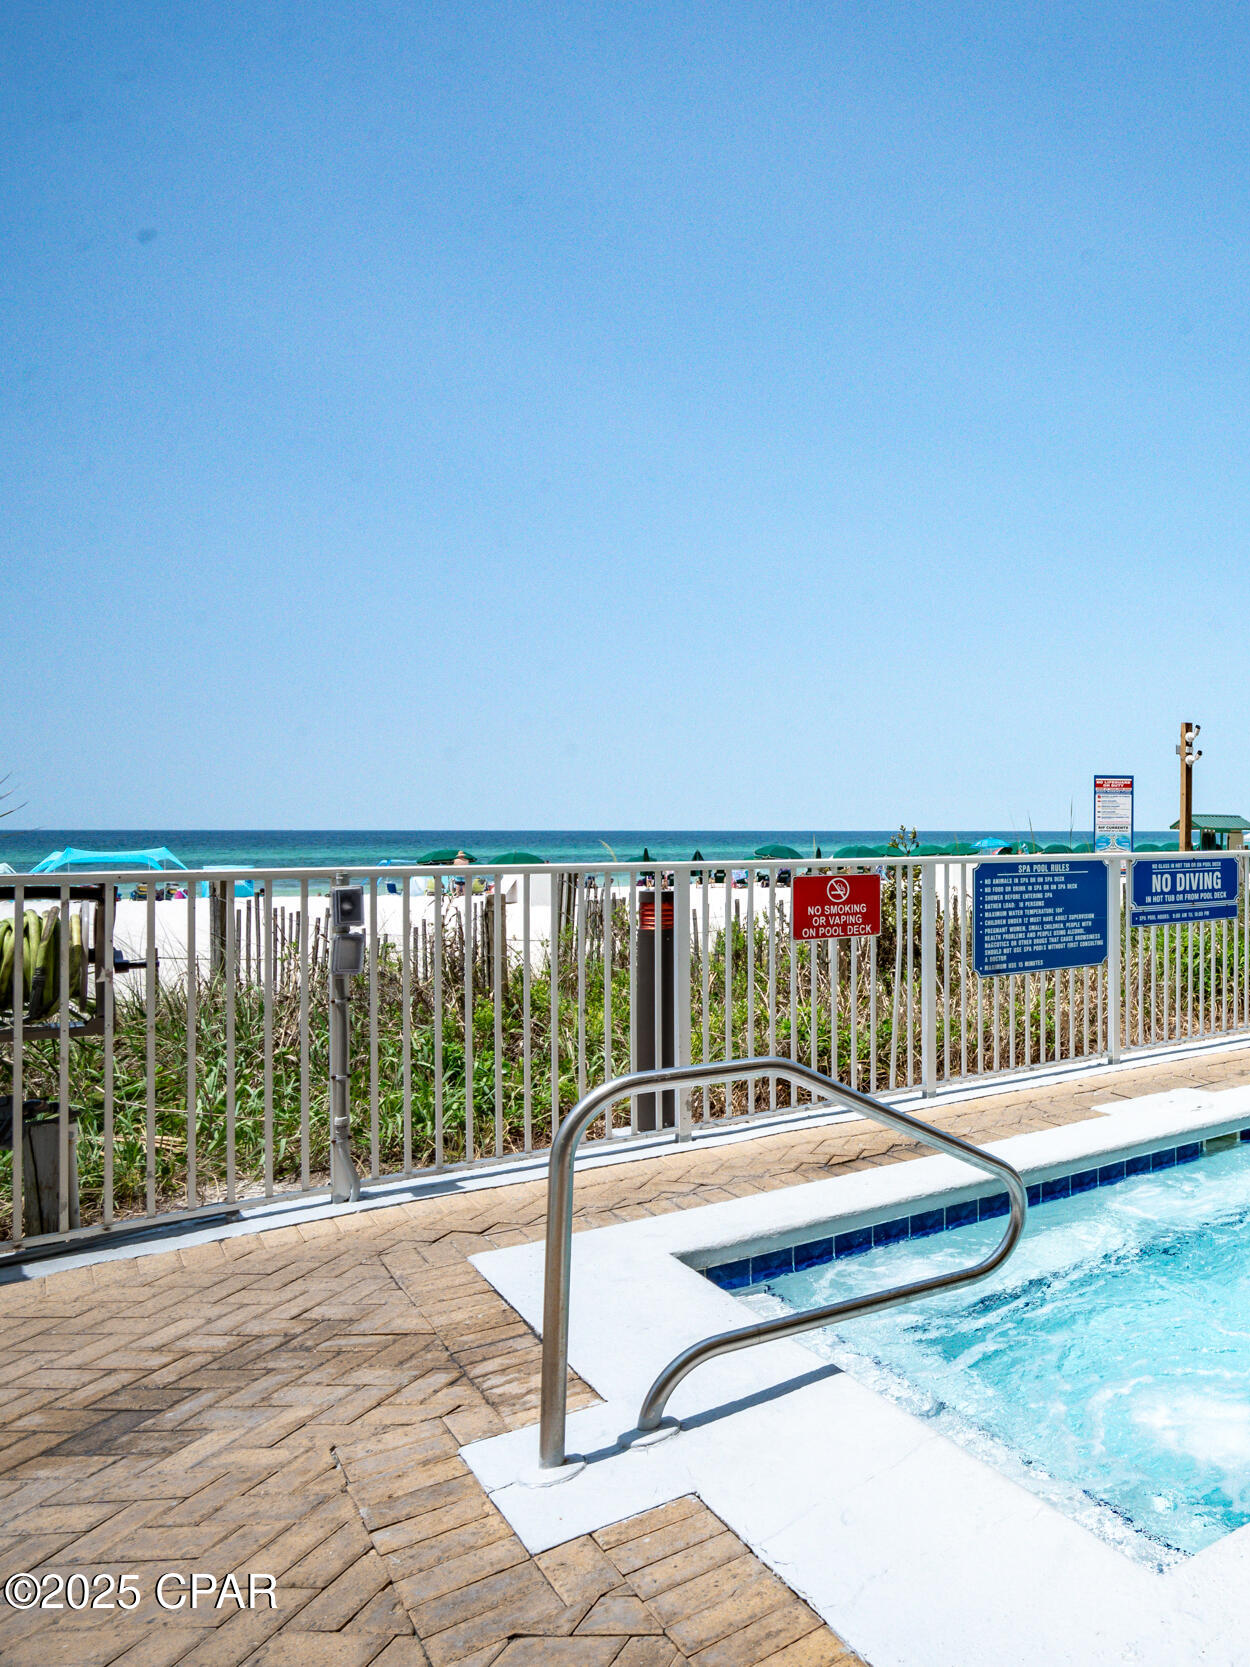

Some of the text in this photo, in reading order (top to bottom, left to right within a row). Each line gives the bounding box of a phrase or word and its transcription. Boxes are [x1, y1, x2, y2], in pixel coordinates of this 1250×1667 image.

[1018, 863, 1070, 873] SPA POOL RULES
[1152, 871, 1222, 893] NO DIVING
[1152, 895, 1163, 903] HOT
[1165, 894, 1175, 902] TUB
[1184, 893, 1199, 901] FROM
[1200, 892, 1213, 900] POOL
[1213, 891, 1227, 899] DECK
[808, 904, 867, 915] NO SMOKING
[812, 914, 862, 926] OR VAPING
[802, 924, 872, 938] ON POOL DECK
